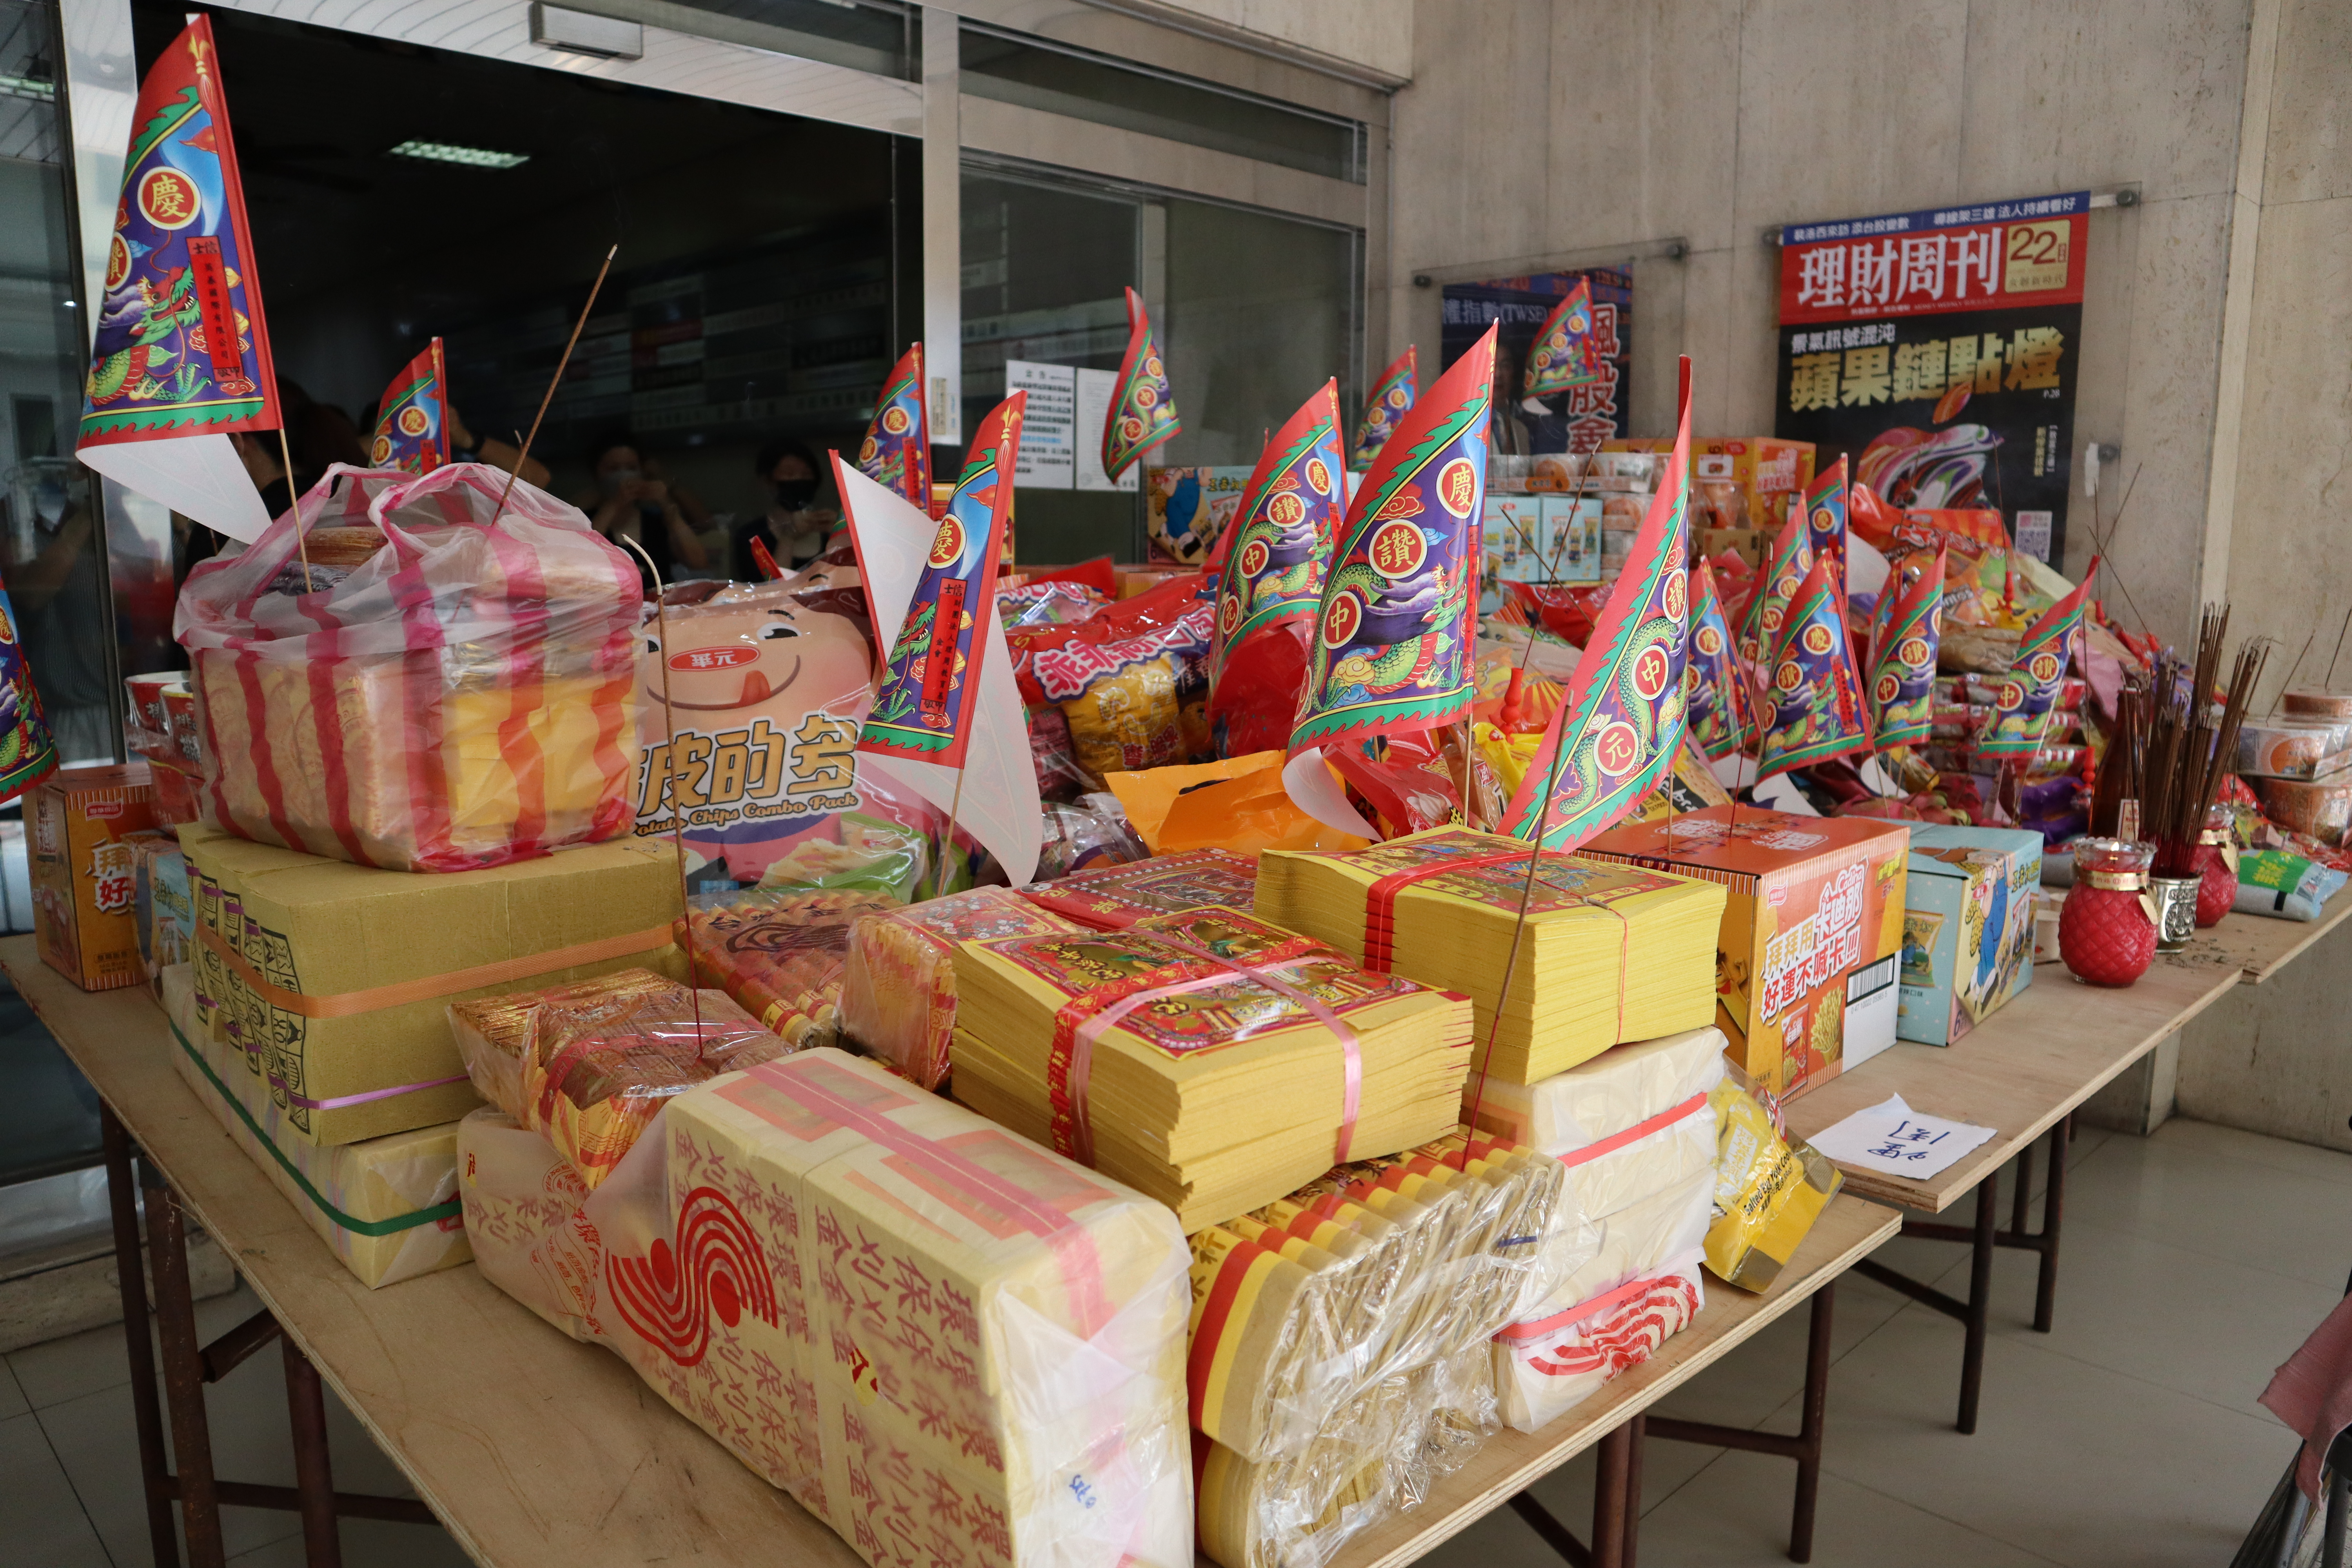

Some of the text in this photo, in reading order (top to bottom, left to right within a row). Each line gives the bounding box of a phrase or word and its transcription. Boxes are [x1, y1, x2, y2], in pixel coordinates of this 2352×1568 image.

[150, 175, 188, 217] 慶
[2011, 227, 2057, 265] 22
[1798, 227, 2003, 308] 理財周刊
[1792, 323, 1896, 354] 景氣訊號混沌
[1790, 327, 2064, 412] 蘋果鏈點燈
[1449, 465, 1471, 507] 慶
[1272, 497, 1299, 521] 讚
[1245, 547, 1261, 571] 中
[1376, 529, 1417, 568] 讚
[1329, 607, 1350, 639] 中
[690, 651, 738, 668] 華元
[1605, 577, 1685, 768] 讚 中 元
[689, 807, 739, 828] Chips
[742, 798, 806, 818] Combo
[809, 793, 858, 811] Pack
[98, 877, 129, 906] 好
[1838, 869, 1864, 891] Cadina
[1767, 881, 1863, 974] 拜拜用 卡迪那
[1743, 1187, 1763, 1216] Salted
